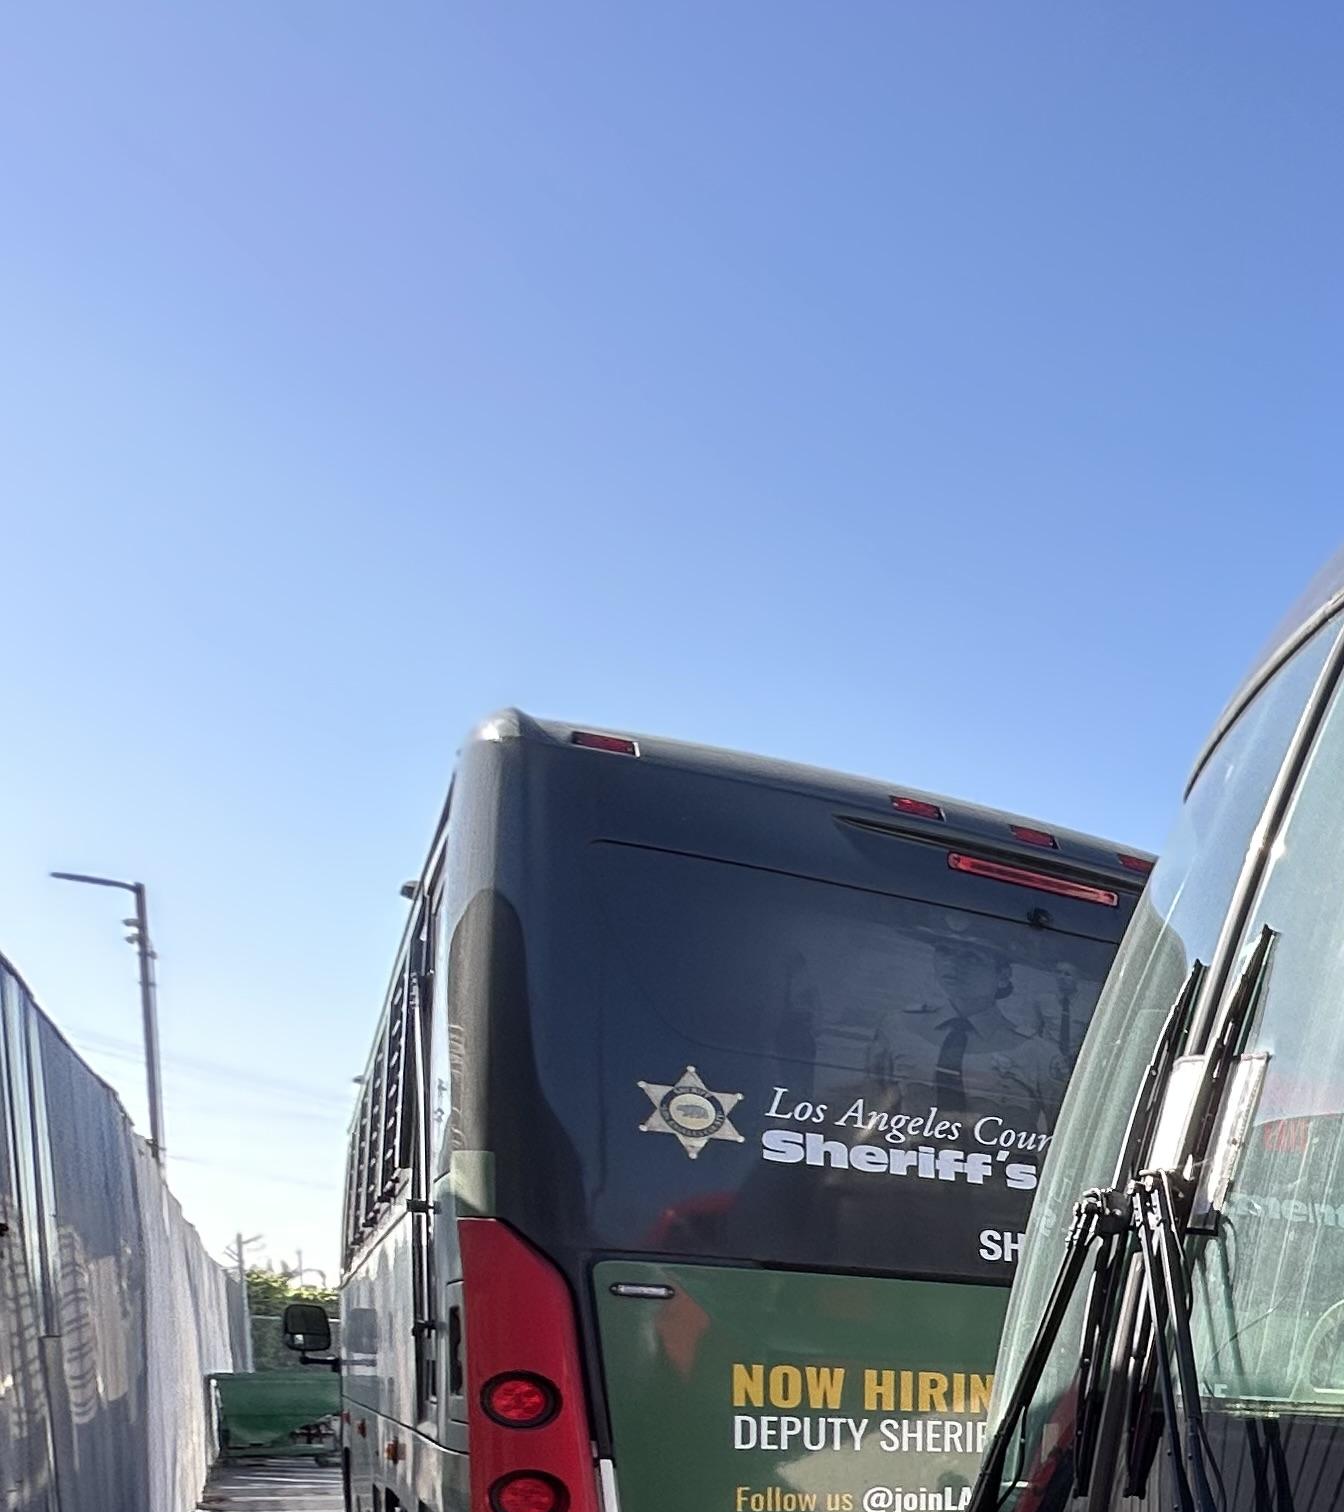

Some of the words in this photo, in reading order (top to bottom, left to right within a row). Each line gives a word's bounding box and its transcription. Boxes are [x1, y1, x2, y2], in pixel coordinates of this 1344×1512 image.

[764, 1087, 828, 1123] Los
[834, 1098, 962, 1143] Angeles
[762, 1129, 1037, 1190] Sheriff's
[732, 1363, 845, 1410] NOW
[733, 1415, 869, 1451] DEPUTY
[736, 1485, 817, 1512] Follow
[826, 1492, 854, 1512] us
